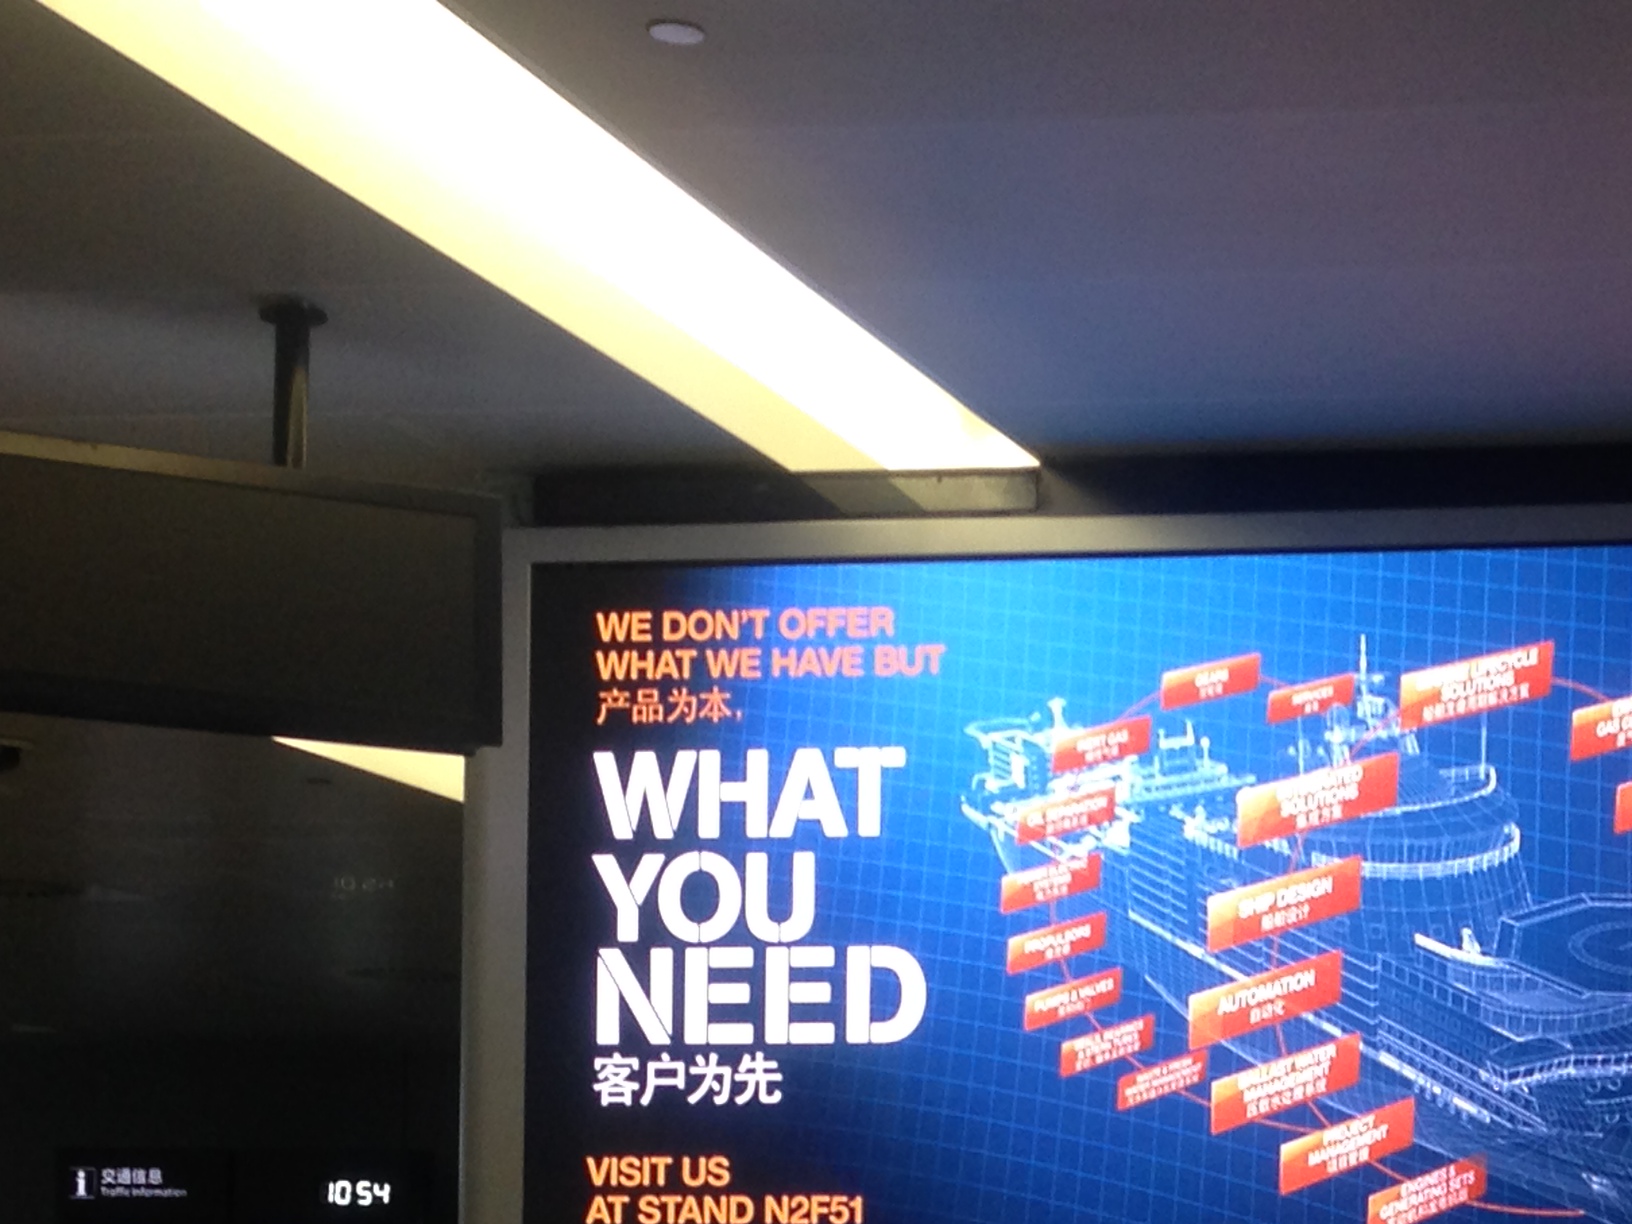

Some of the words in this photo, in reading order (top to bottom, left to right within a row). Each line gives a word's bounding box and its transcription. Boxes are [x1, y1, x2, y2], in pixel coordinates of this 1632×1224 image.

[596, 612, 652, 642] WE
[662, 610, 770, 640] DON'T
[778, 606, 895, 637] OFFER
[596, 650, 696, 680] WHAT
[706, 648, 761, 678] WE
[771, 646, 865, 677] HAVE
[874, 643, 946, 676] BUT
[593, 747, 906, 840] WHAT
[591, 850, 816, 943] YOU
[1238, 893, 1275, 919] SHIP
[1276, 876, 1333, 908] DESIGN
[596, 945, 927, 1045] NEED
[1217, 968, 1316, 1016] AUTOMATION
[592, 1051, 783, 1107] 客户为先
[100, 1167, 163, 1185] 交通信息
[586, 1156, 673, 1187] VISIT
[682, 1155, 731, 1187] US
